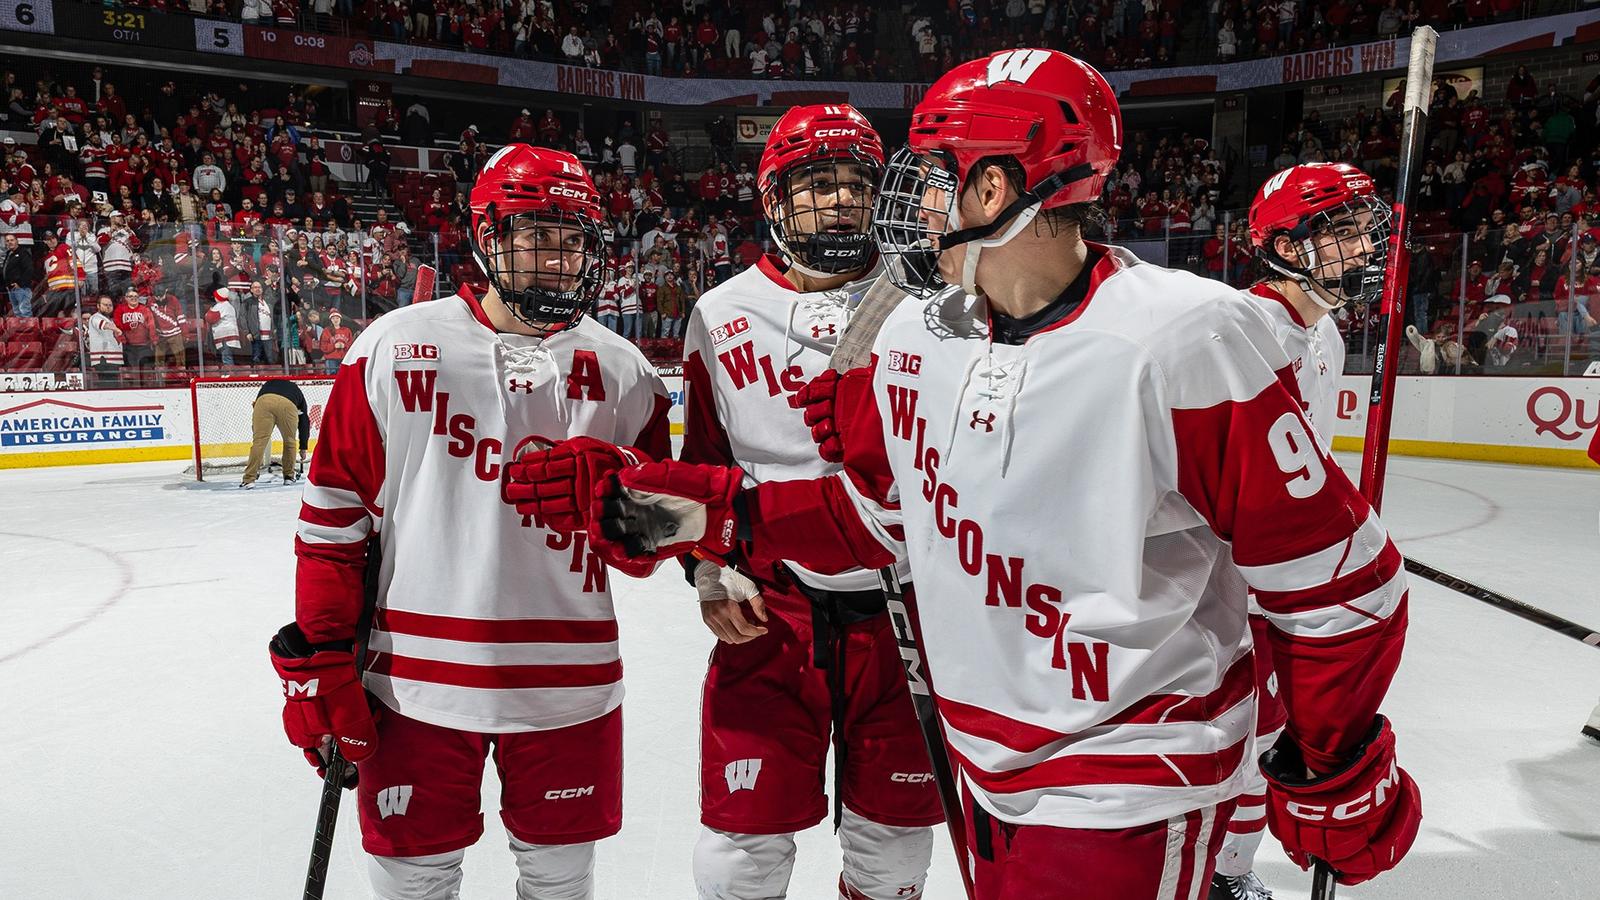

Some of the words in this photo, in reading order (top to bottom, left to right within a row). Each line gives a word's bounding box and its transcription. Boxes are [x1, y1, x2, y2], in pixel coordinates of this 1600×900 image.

[15, 3, 35, 25] 6
[103, 10, 145, 29] 3:21
[113, 29, 140, 40] OT/1
[213, 28, 230, 48] 5
[260, 31, 277, 42] 10
[294, 35, 325, 48] 0:08
[987, 50, 1053, 88] W
[1282, 47, 1353, 84] BADGERS
[1360, 41, 1396, 73] WIN
[557, 65, 614, 98] BADGERS
[619, 71, 646, 101] WIN
[815, 128, 857, 137] CCM
[926, 179, 955, 192] CCM
[1346, 179, 1371, 189] CCM
[548, 186, 588, 201] CCM
[823, 249, 861, 257] CCM
[538, 303, 575, 316] CCM
[1375, 343, 1385, 374] ZELENOV
[566, 349, 606, 401] A
[1, 416, 94, 431] AMERICAN
[102, 414, 162, 427] FAMILY
[14, 430, 152, 444] INSURANCE
[887, 384, 1110, 702] WISCONSIN
[340, 736, 367, 747] CCM
[725, 758, 762, 794] W
[544, 785, 595, 800] CCM
[1286, 758, 1400, 821] CCM
[377, 785, 413, 819] W
